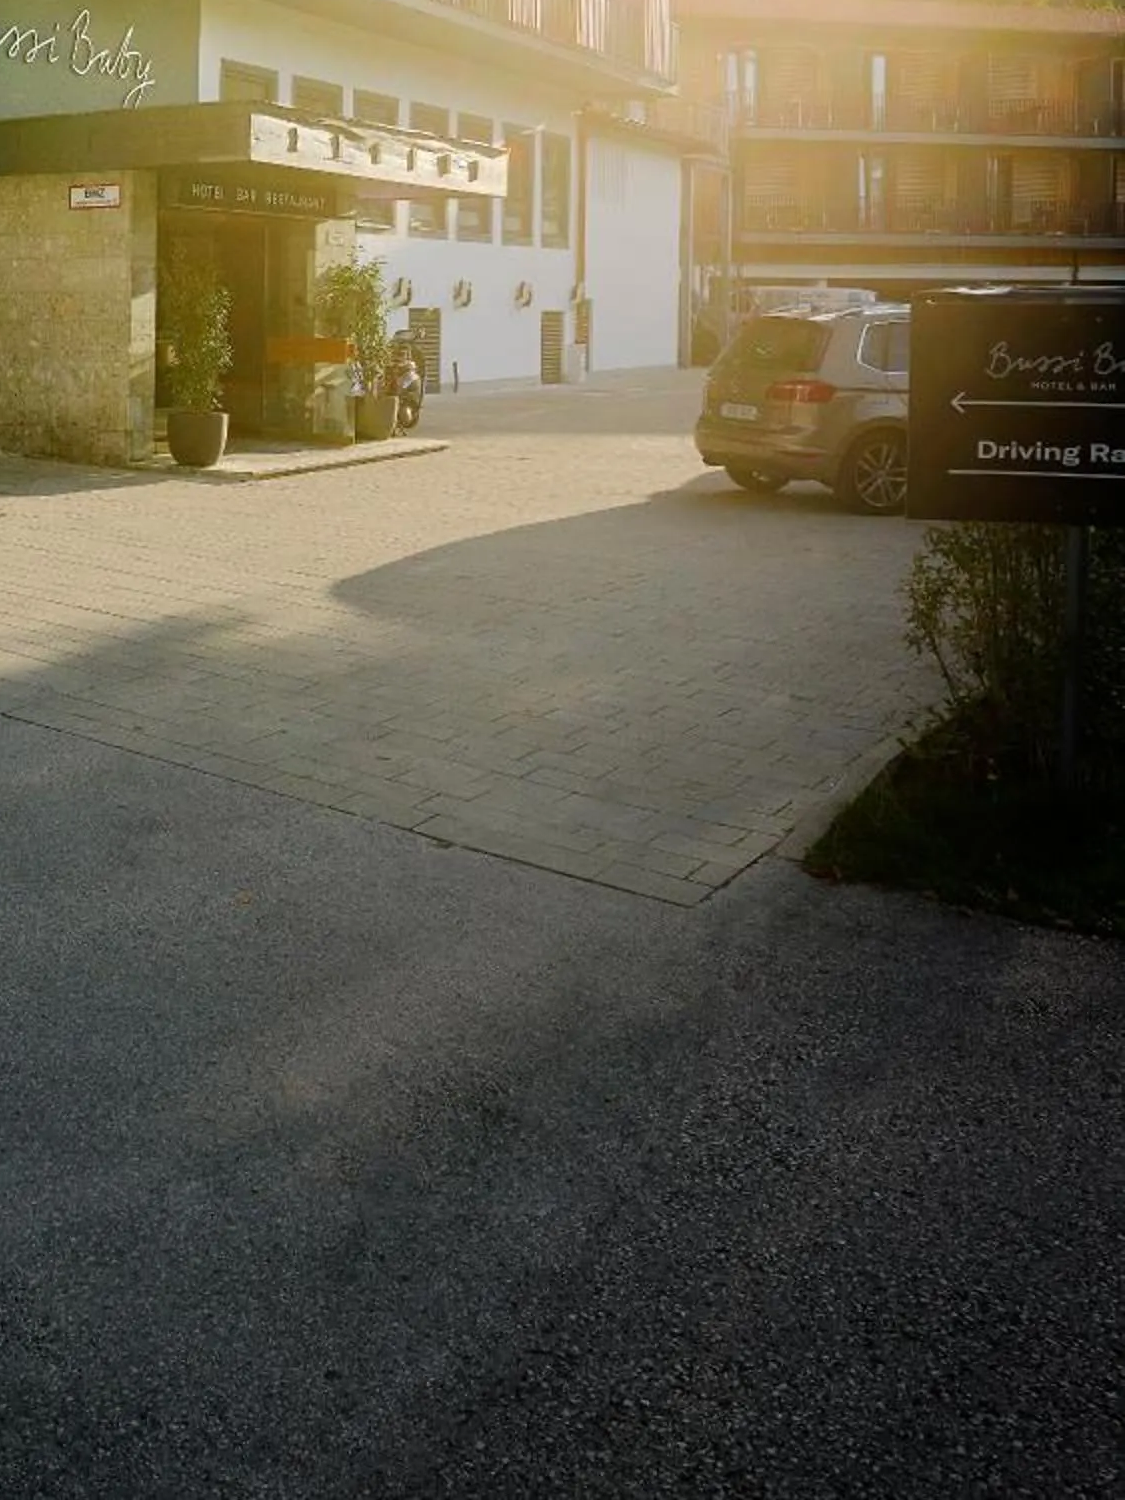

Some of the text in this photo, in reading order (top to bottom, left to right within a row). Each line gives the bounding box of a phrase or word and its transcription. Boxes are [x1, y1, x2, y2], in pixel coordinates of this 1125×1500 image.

[71, 8, 156, 110] Baby
[192, 183, 224, 200] HOTEL
[236, 187, 257, 203] BAR
[984, 341, 1084, 379] Bussi
[1031, 381, 1074, 391] HOTEL
[1090, 382, 1117, 392] BAR
[977, 440, 1081, 467] Driving
